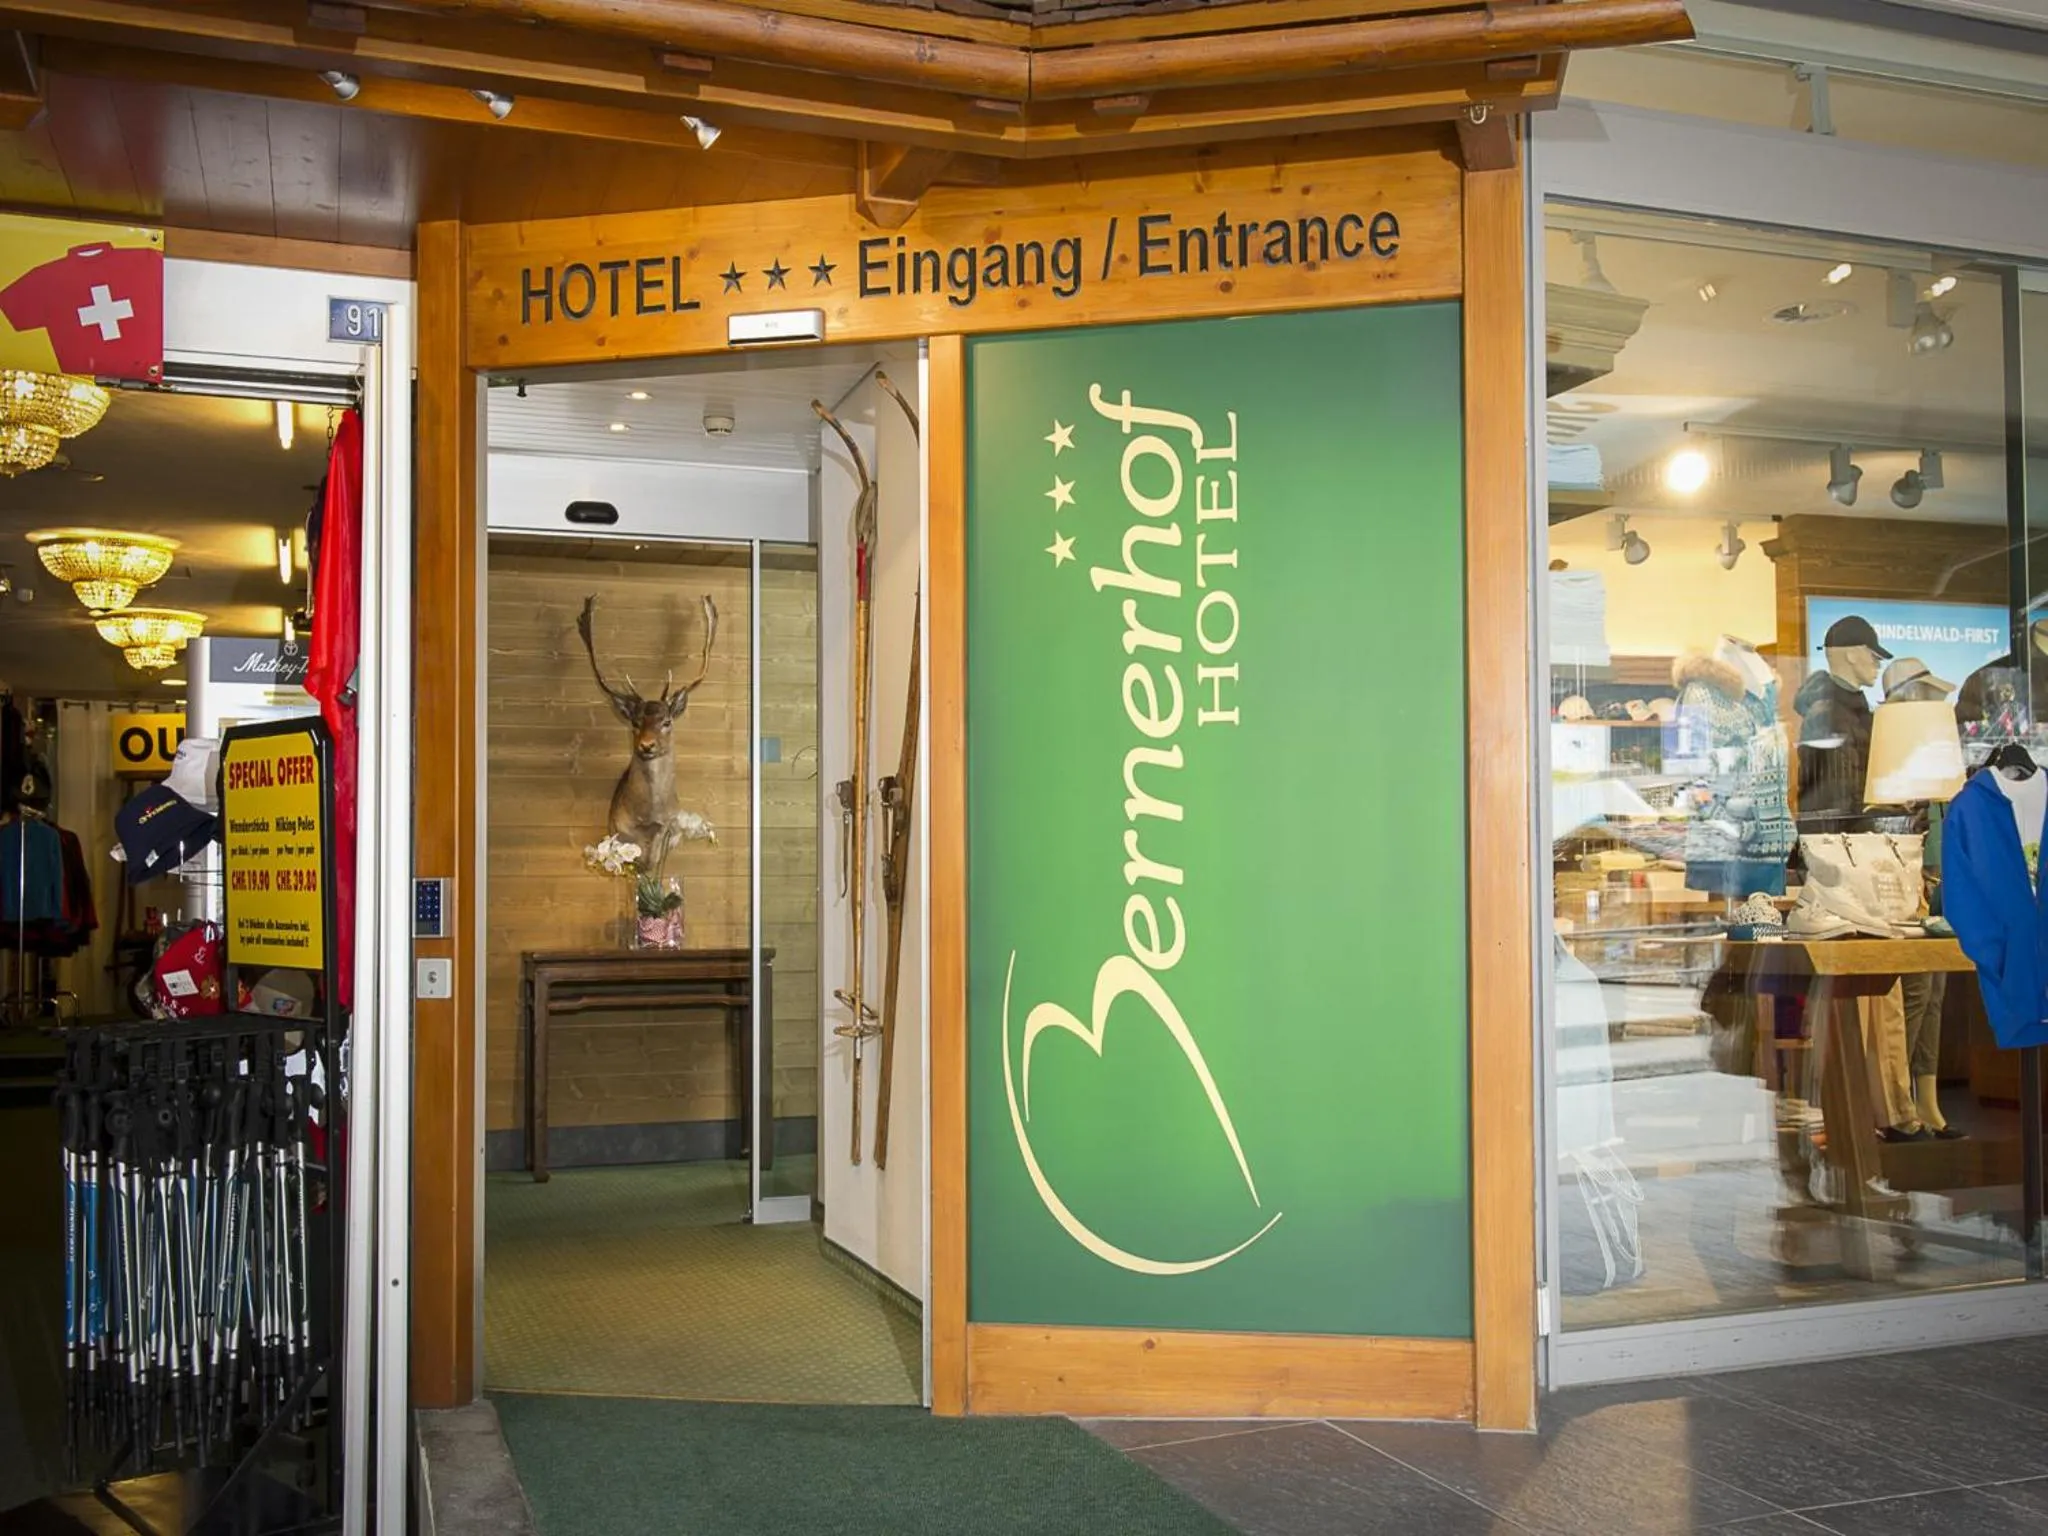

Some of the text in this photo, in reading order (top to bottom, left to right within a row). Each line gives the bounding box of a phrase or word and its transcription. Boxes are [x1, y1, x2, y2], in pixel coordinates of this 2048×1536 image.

[522, 208, 1401, 326] HOTEL Eingang / Entrance
[346, 304, 379, 338] 91
[1195, 411, 1240, 728] HOTEL
[1874, 623, 1999, 644] RINDELWALD-FIRST
[232, 651, 310, 681] Mathey-T
[229, 754, 315, 790] SPECIAL OFFER
[1002, 382, 1284, 1276] Bernerhof
